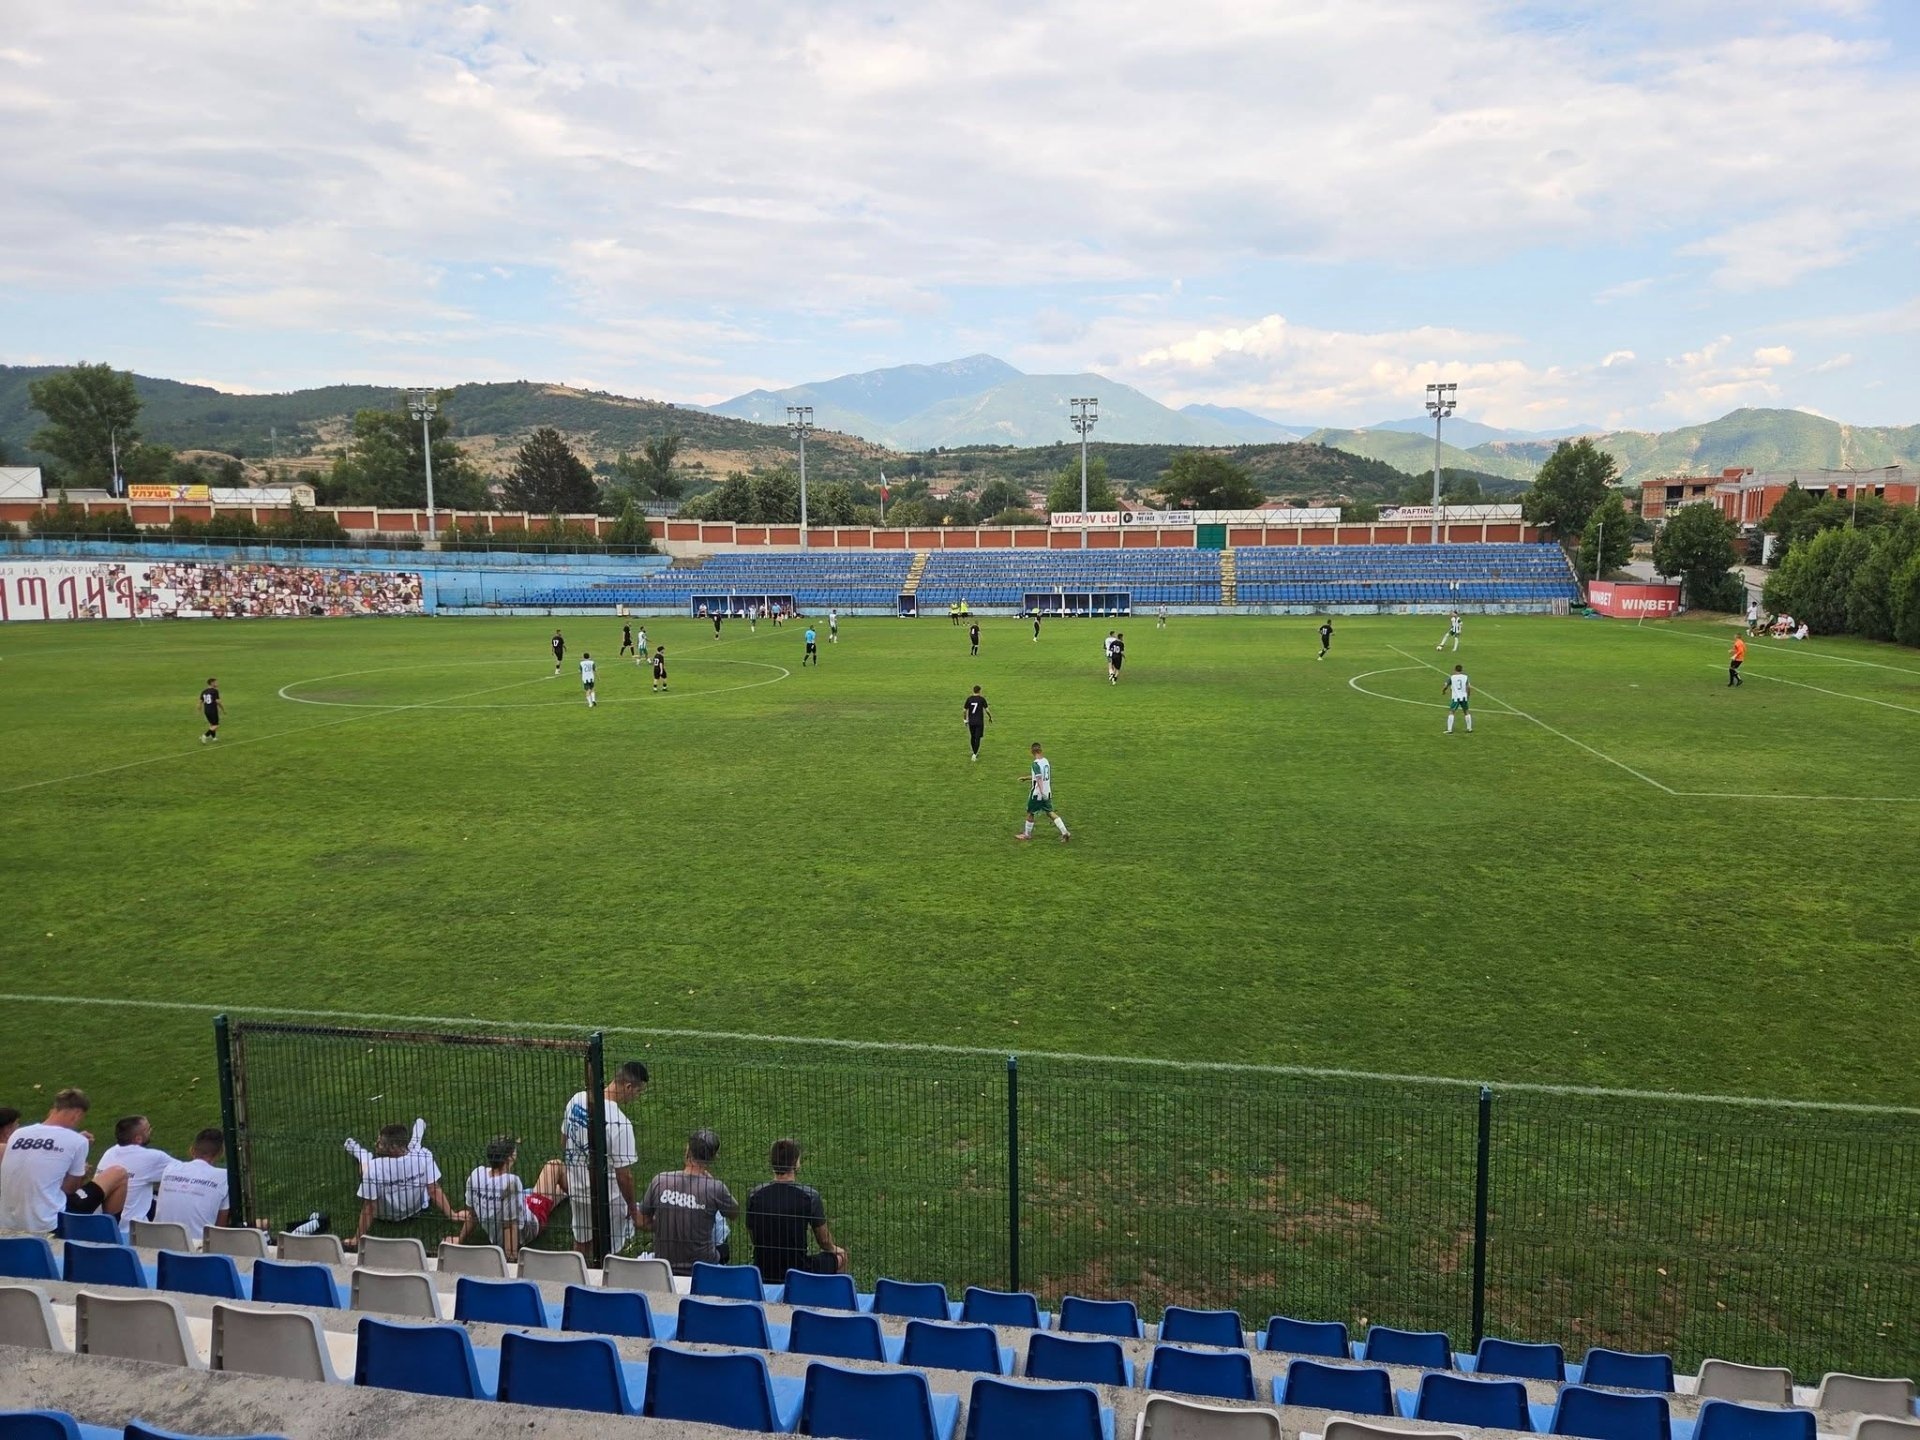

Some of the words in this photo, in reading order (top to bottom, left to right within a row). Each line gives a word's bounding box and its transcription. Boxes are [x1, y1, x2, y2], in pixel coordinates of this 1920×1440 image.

[1054, 515, 1096, 524] VIDIZV
[1101, 514, 1118, 523] Ltd
[1590, 590, 1612, 607] WINBET
[1621, 599, 1675, 611] WINBET
[1457, 679, 1462, 690] 3
[971, 702, 978, 713] 7
